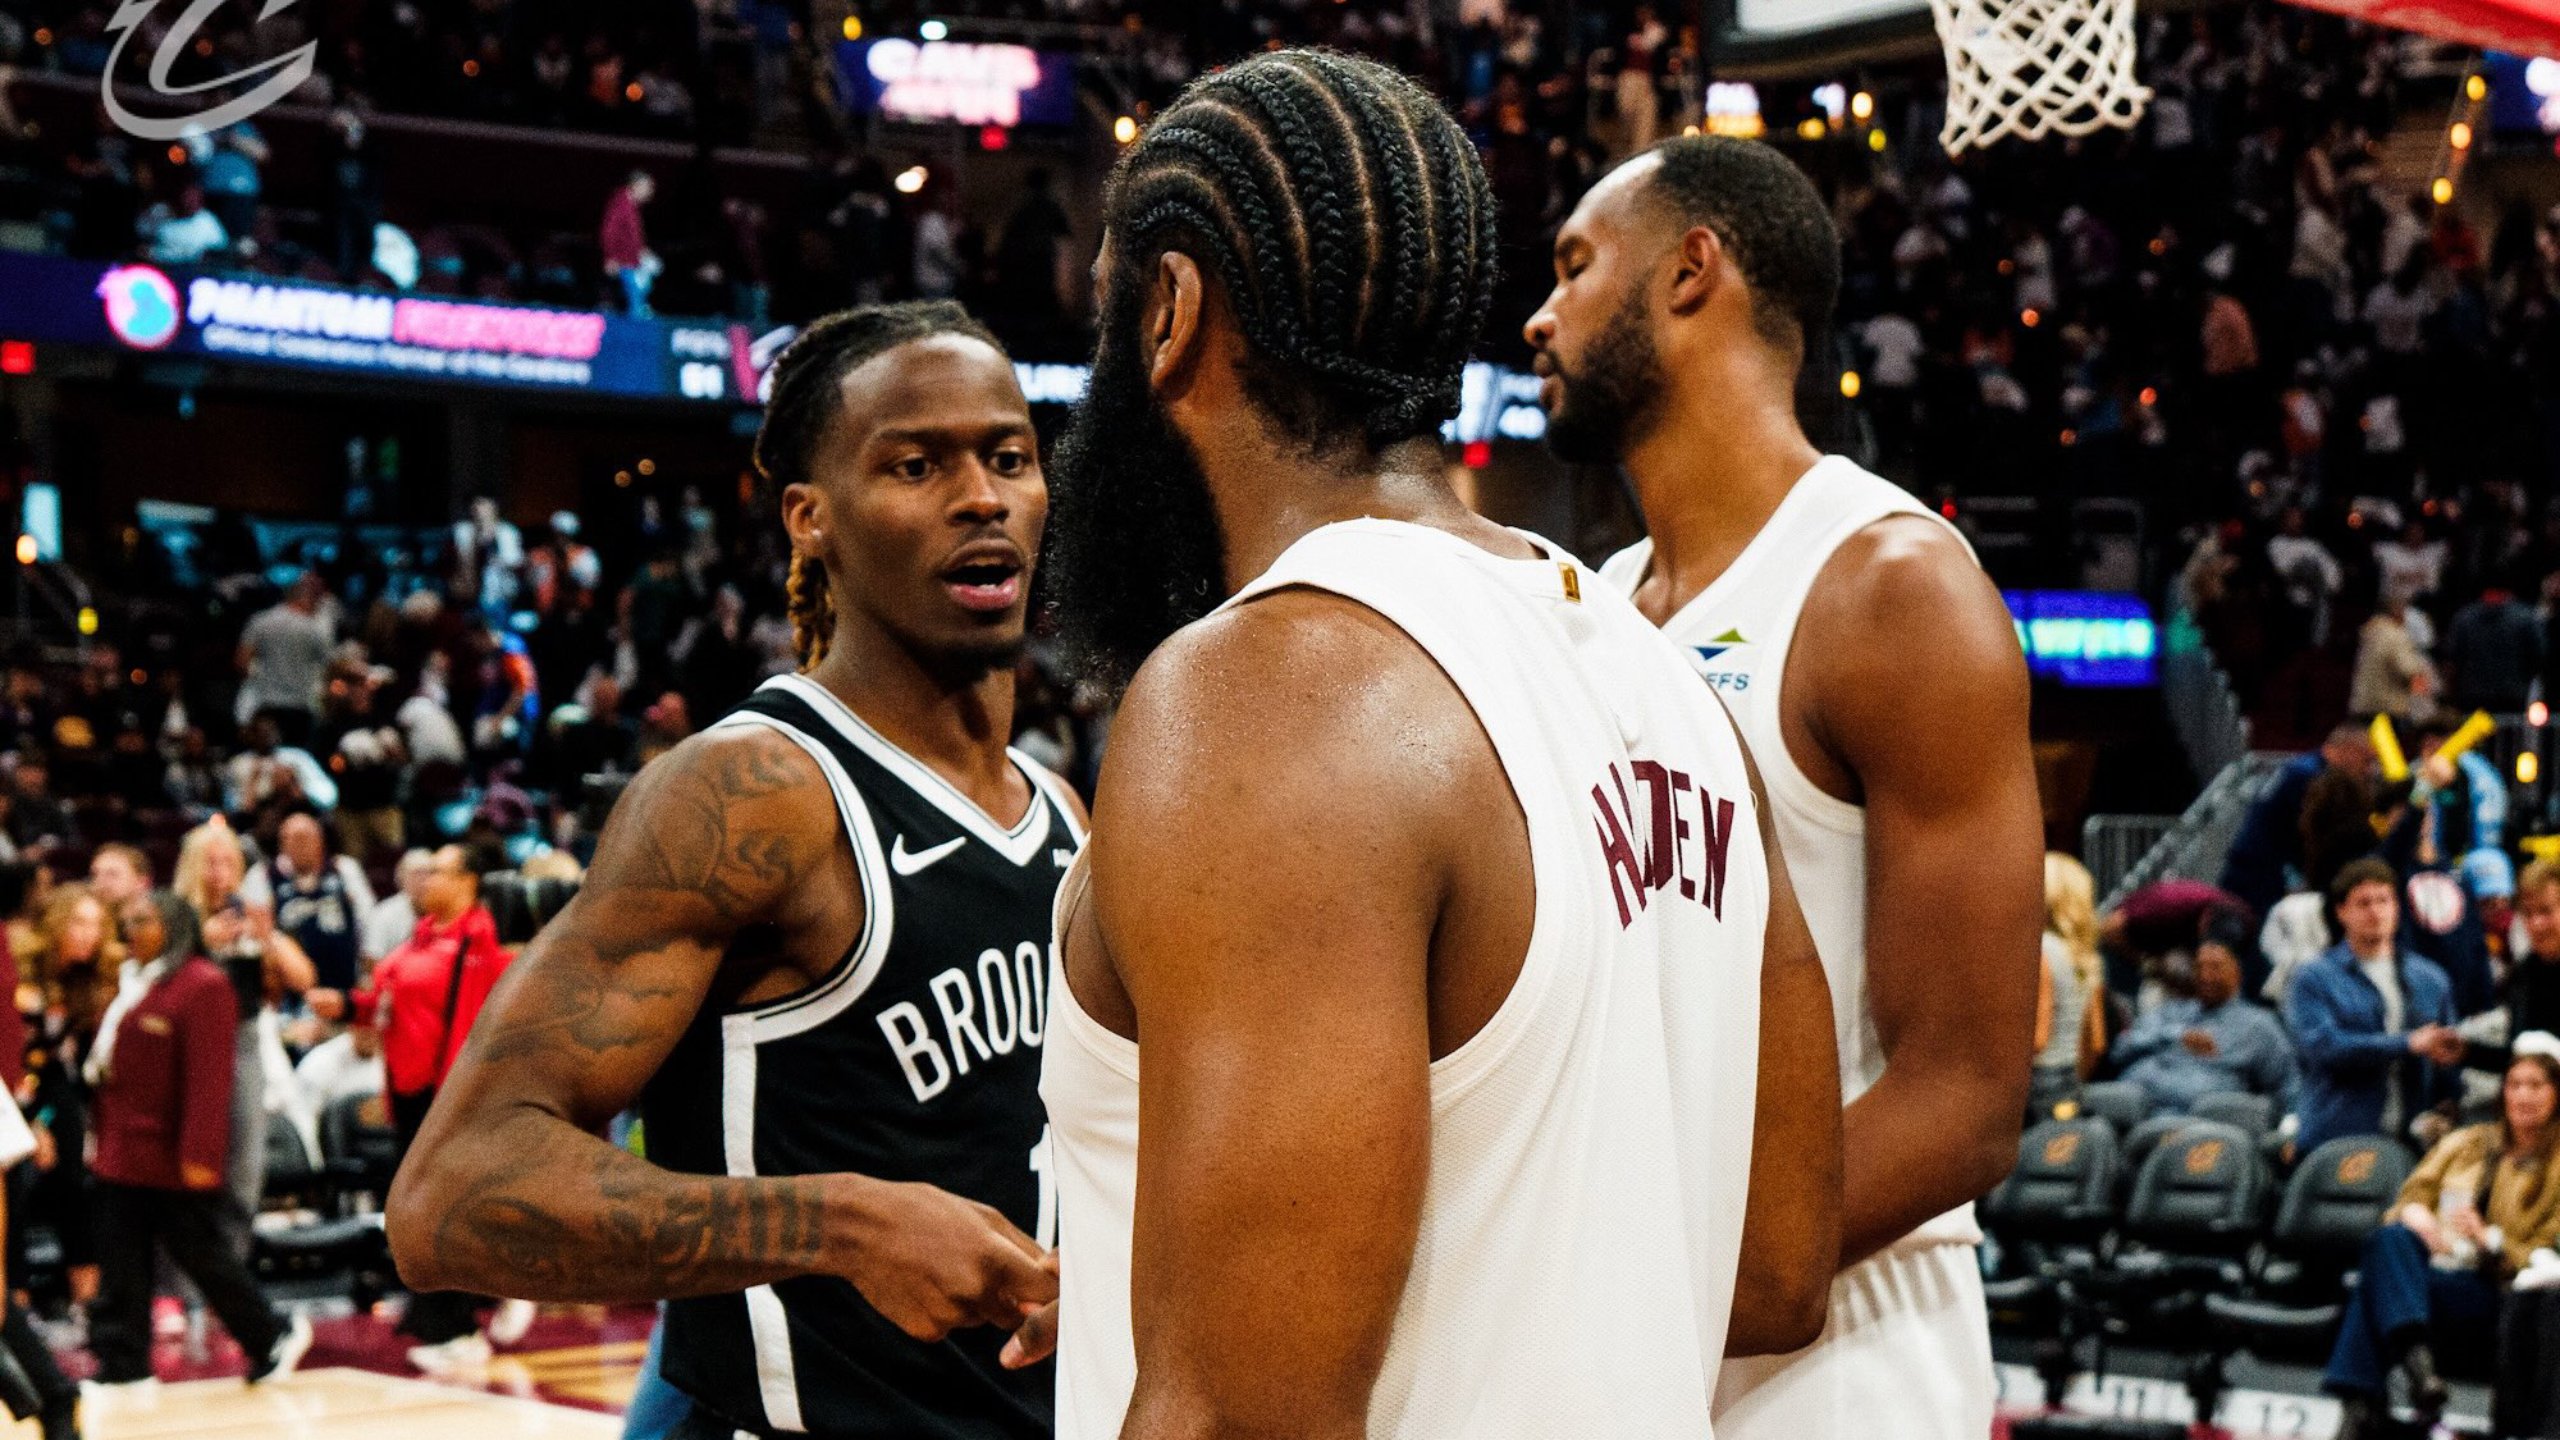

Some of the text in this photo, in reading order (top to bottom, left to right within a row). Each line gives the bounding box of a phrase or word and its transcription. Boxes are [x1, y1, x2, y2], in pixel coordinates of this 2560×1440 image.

[1706, 673, 1750, 691] FFS
[1591, 760, 1735, 931] HDEN
[876, 941, 1053, 1102] BROO
